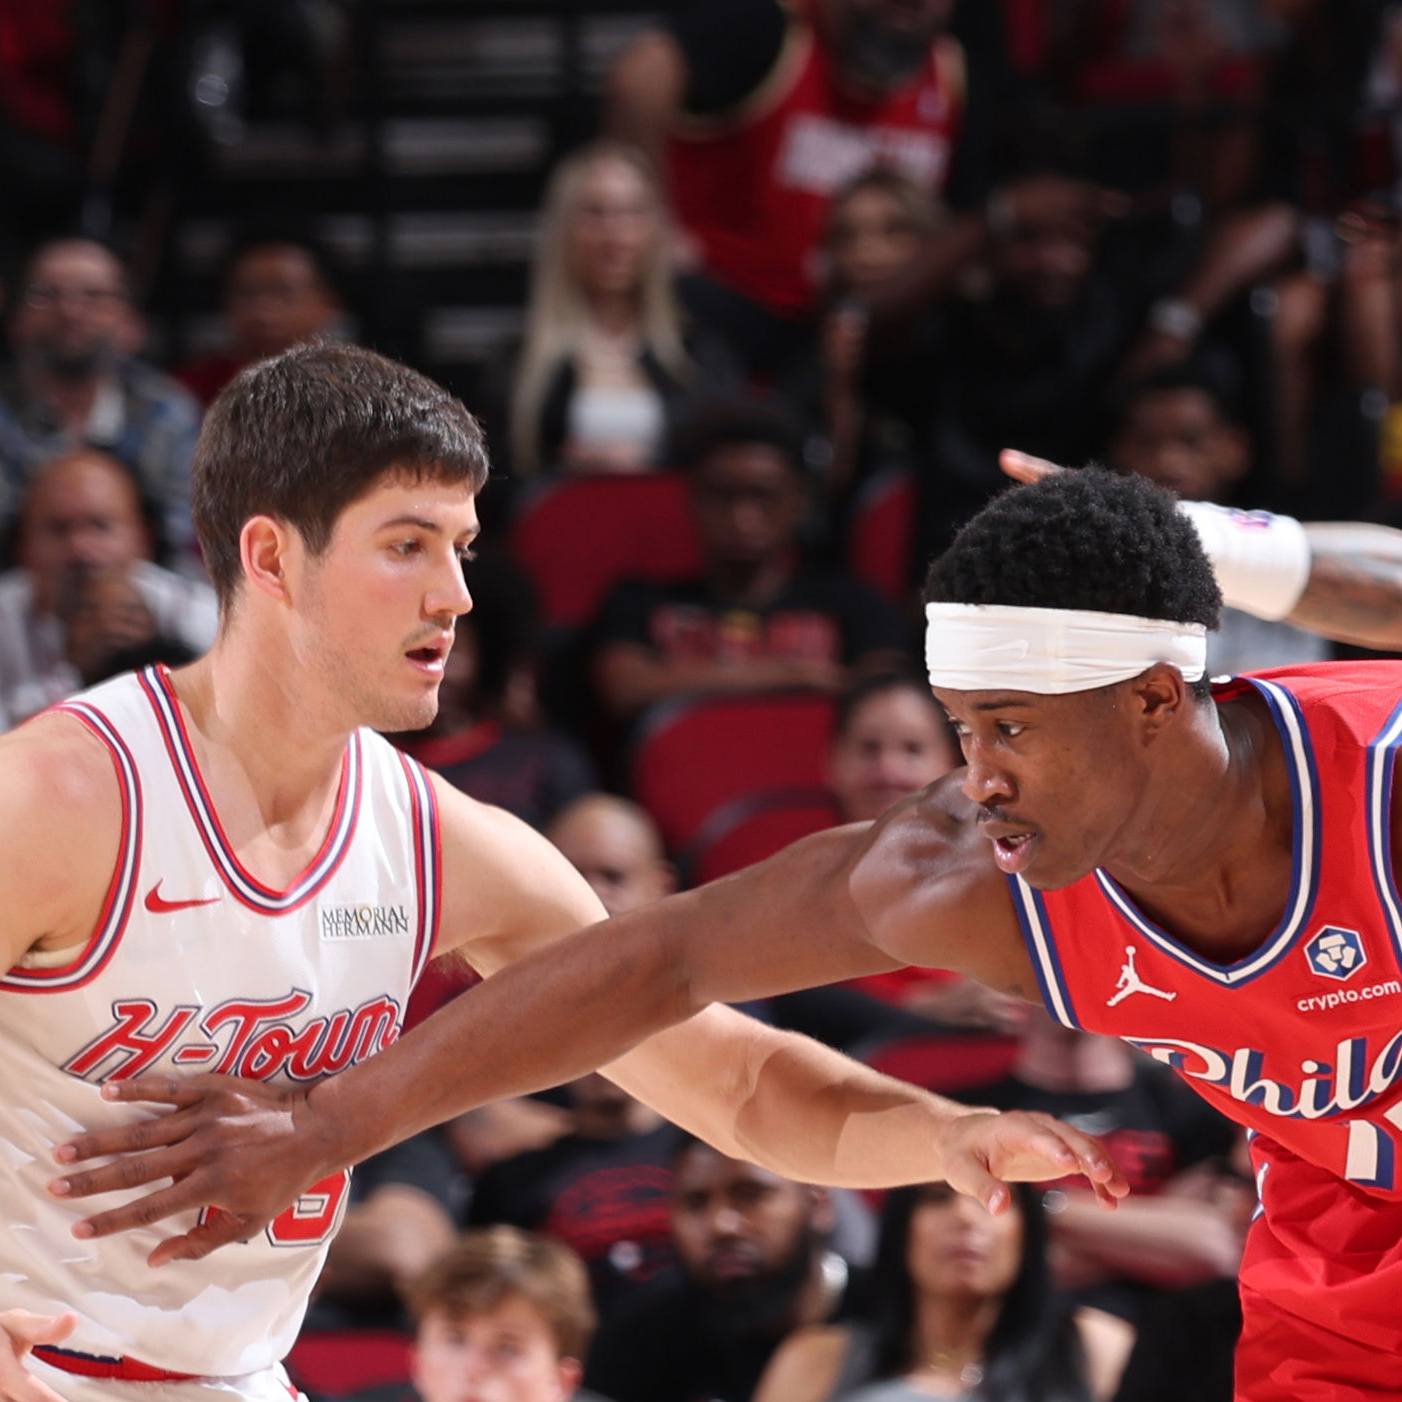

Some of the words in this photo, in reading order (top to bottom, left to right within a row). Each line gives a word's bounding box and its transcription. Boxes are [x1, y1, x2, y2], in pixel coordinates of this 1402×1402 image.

[322, 905, 409, 924] MEMORIAL
[322, 919, 409, 938] HERMANN
[1297, 979, 1401, 1013] crypto.com
[60, 987, 401, 1086] H-Town
